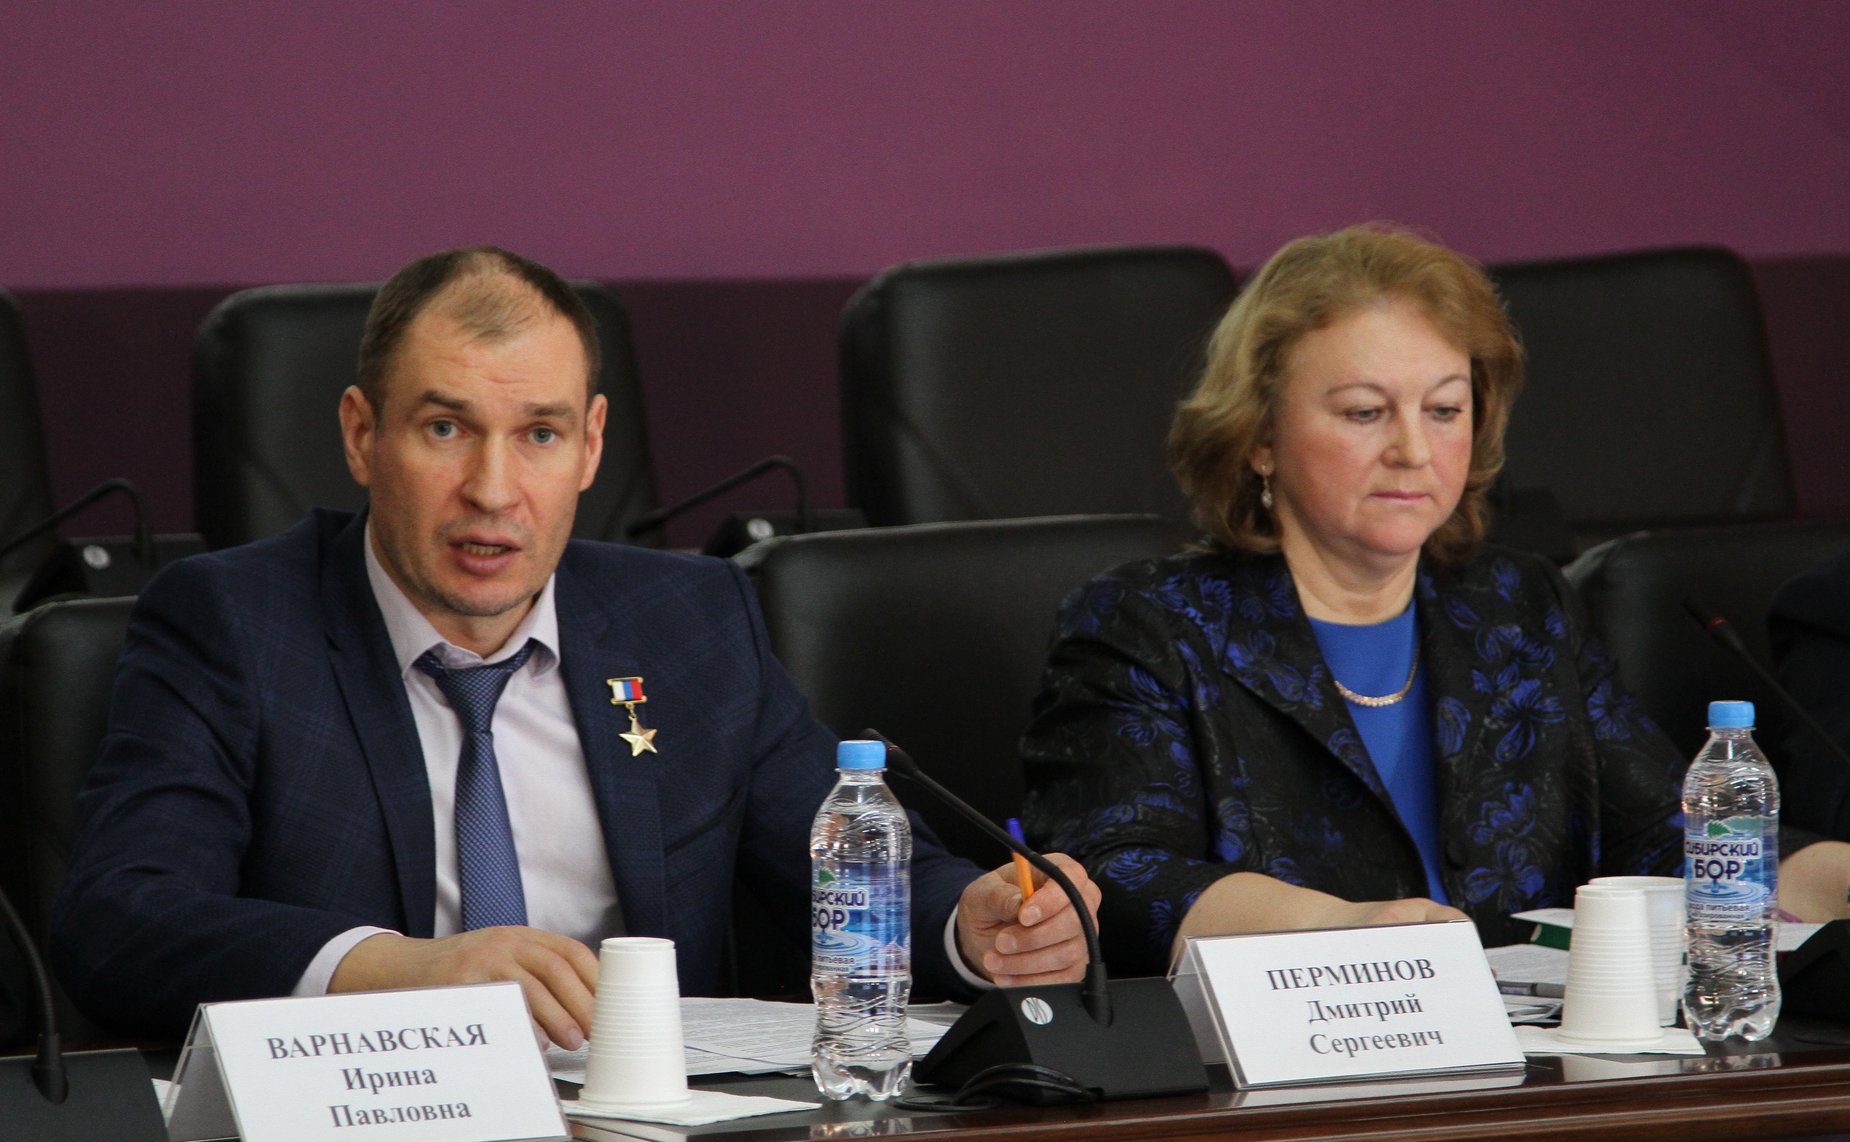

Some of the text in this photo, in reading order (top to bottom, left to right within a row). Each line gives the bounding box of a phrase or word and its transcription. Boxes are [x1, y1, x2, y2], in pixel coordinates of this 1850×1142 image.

[1695, 859, 1740, 880] БОР
[1266, 958, 1436, 991] ПЕРМИНОВ
[1307, 993, 1424, 1024] Дмитрий
[267, 1023, 489, 1060] ВАРНАВСКАЯ
[1309, 1029, 1444, 1058] Сергеевич
[341, 1067, 438, 1095] Ирина
[329, 1100, 472, 1128] Павловна
